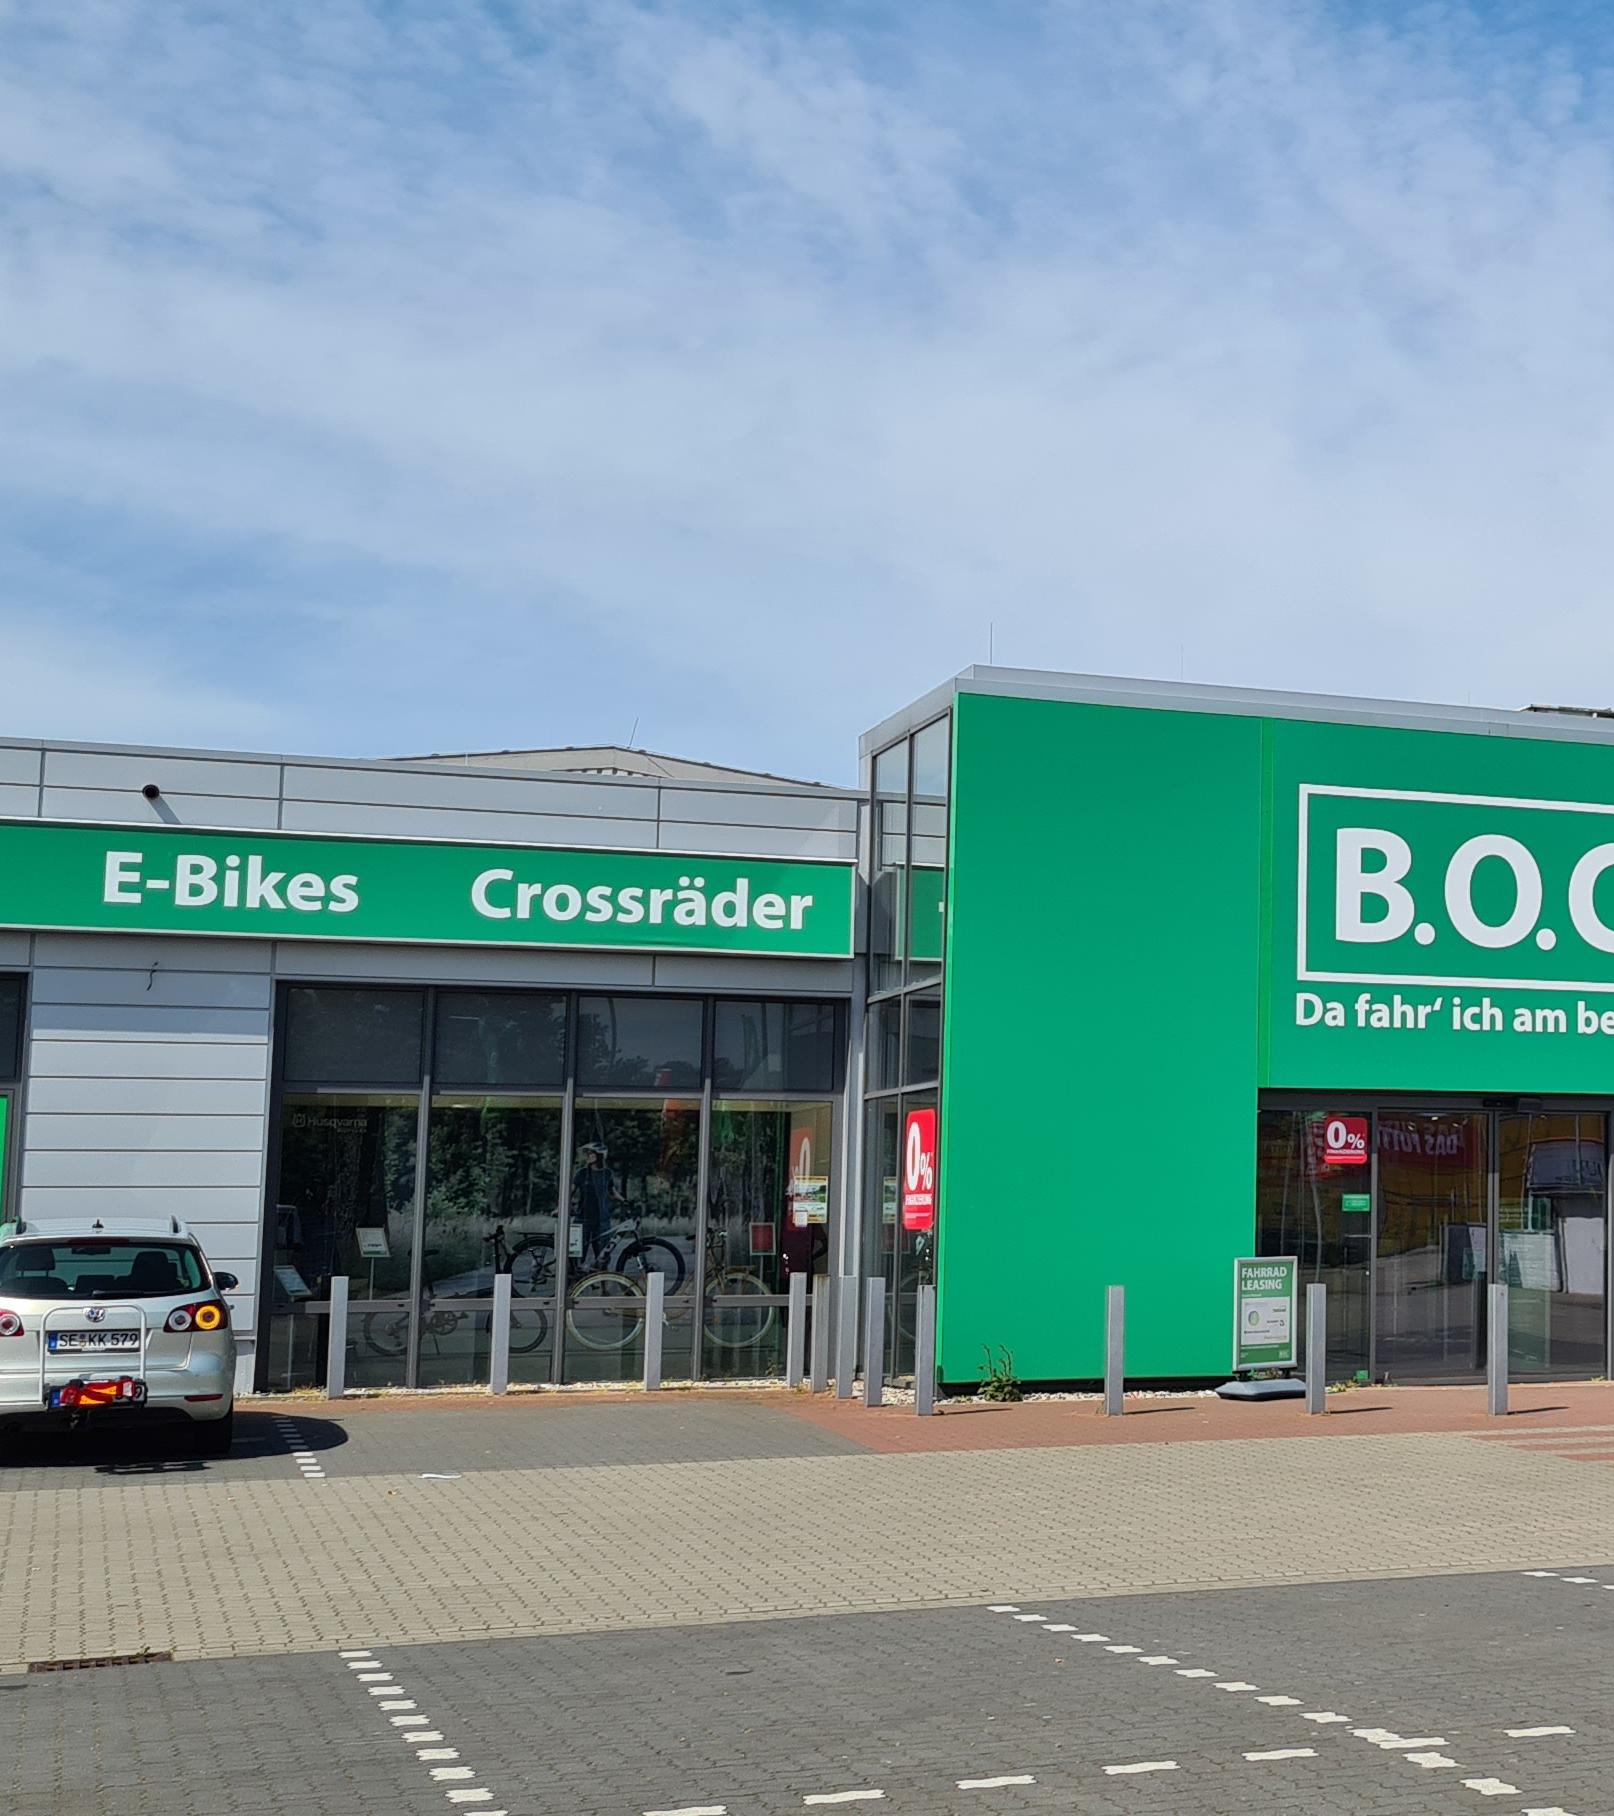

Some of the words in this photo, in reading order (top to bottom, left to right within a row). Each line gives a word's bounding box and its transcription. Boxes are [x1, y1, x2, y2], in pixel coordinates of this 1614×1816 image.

[103, 851, 359, 913] E-Bikes
[471, 868, 813, 930] Crossräder
[1295, 992, 1345, 1027] Da
[1452, 996, 1503, 1031] ich
[1513, 1007, 1567, 1033] am
[1327, 1121, 1365, 1149] 0%
[1241, 1266, 1288, 1278] FAHRRAD
[1241, 1279, 1283, 1291] LEASING
[60, 1333, 78, 1347] SE
[88, 1333, 107, 1347] KK
[110, 1333, 138, 1346] 579
